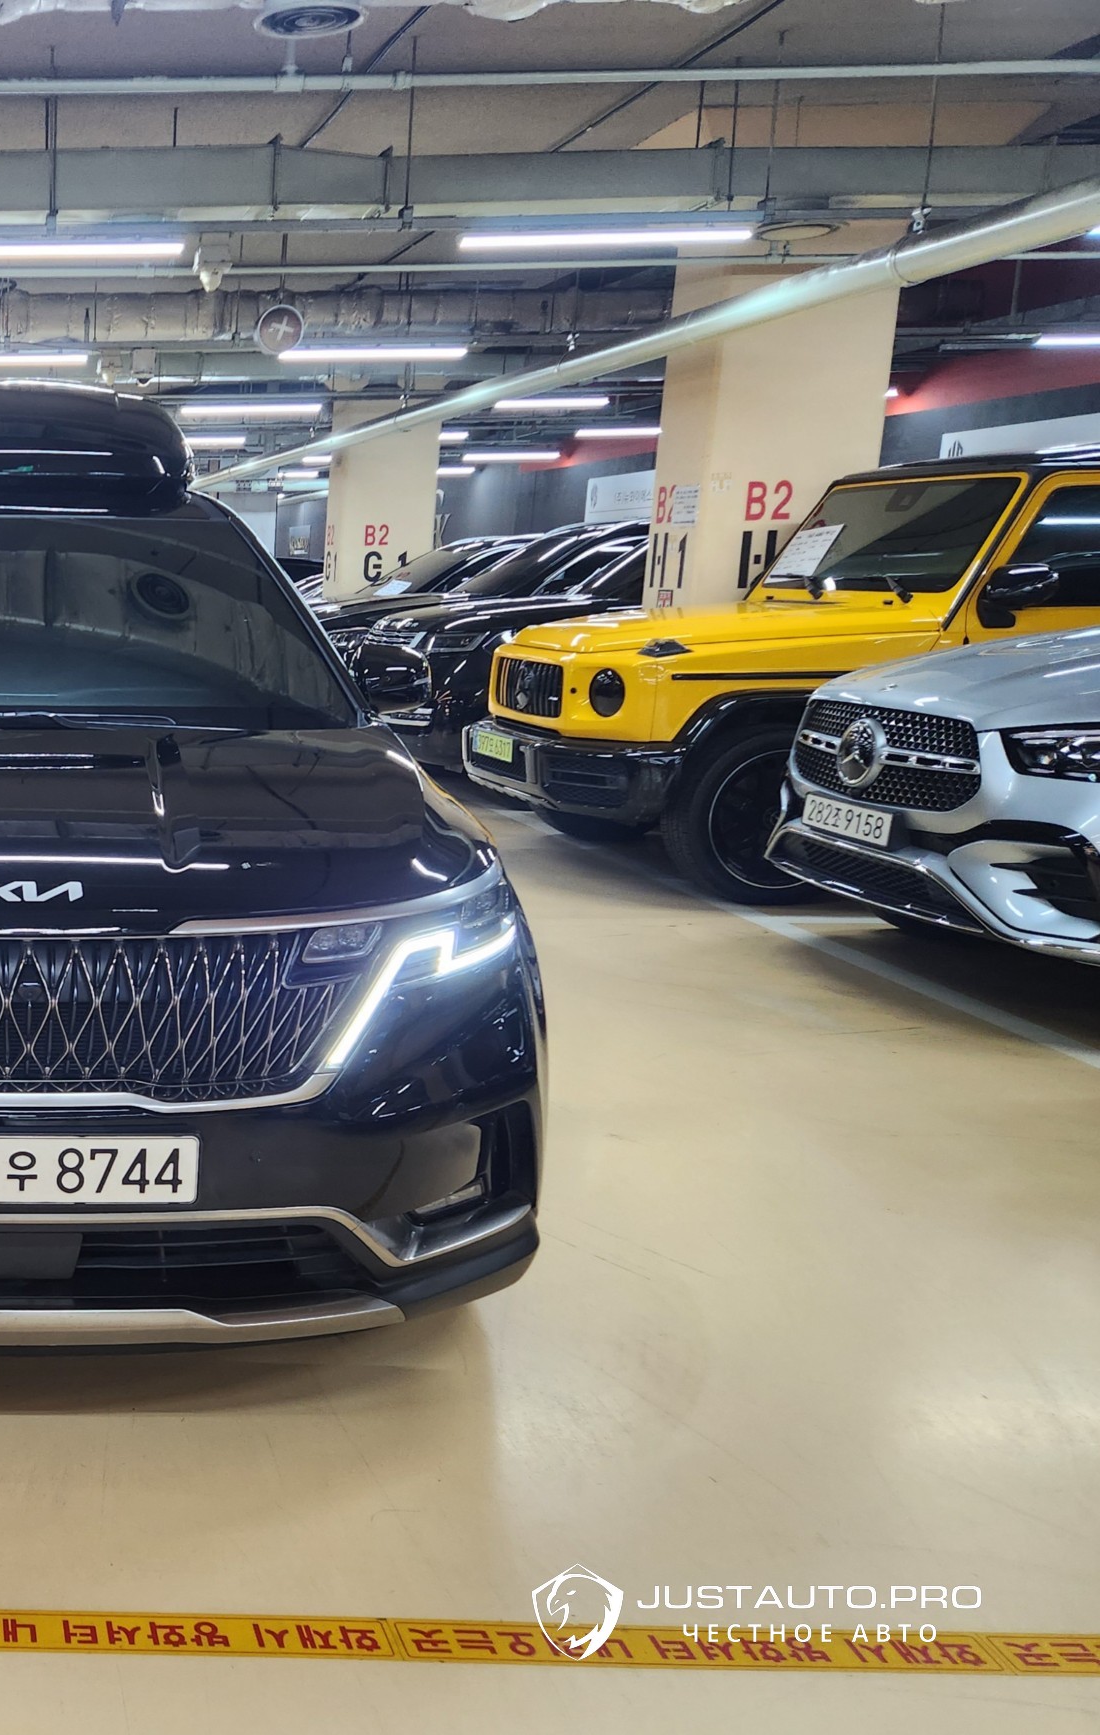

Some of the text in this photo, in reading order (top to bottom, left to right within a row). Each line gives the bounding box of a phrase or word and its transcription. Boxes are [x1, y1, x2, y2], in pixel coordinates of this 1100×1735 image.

[744, 479, 793, 521] B2
[326, 525, 335, 546] B2
[364, 524, 389, 546] B2
[844, 811, 885, 840] 9158
[56, 1147, 183, 1194] 8744
[63, 1619, 231, 1648] 방화셔터
[255, 1623, 381, 1652] 화재시
